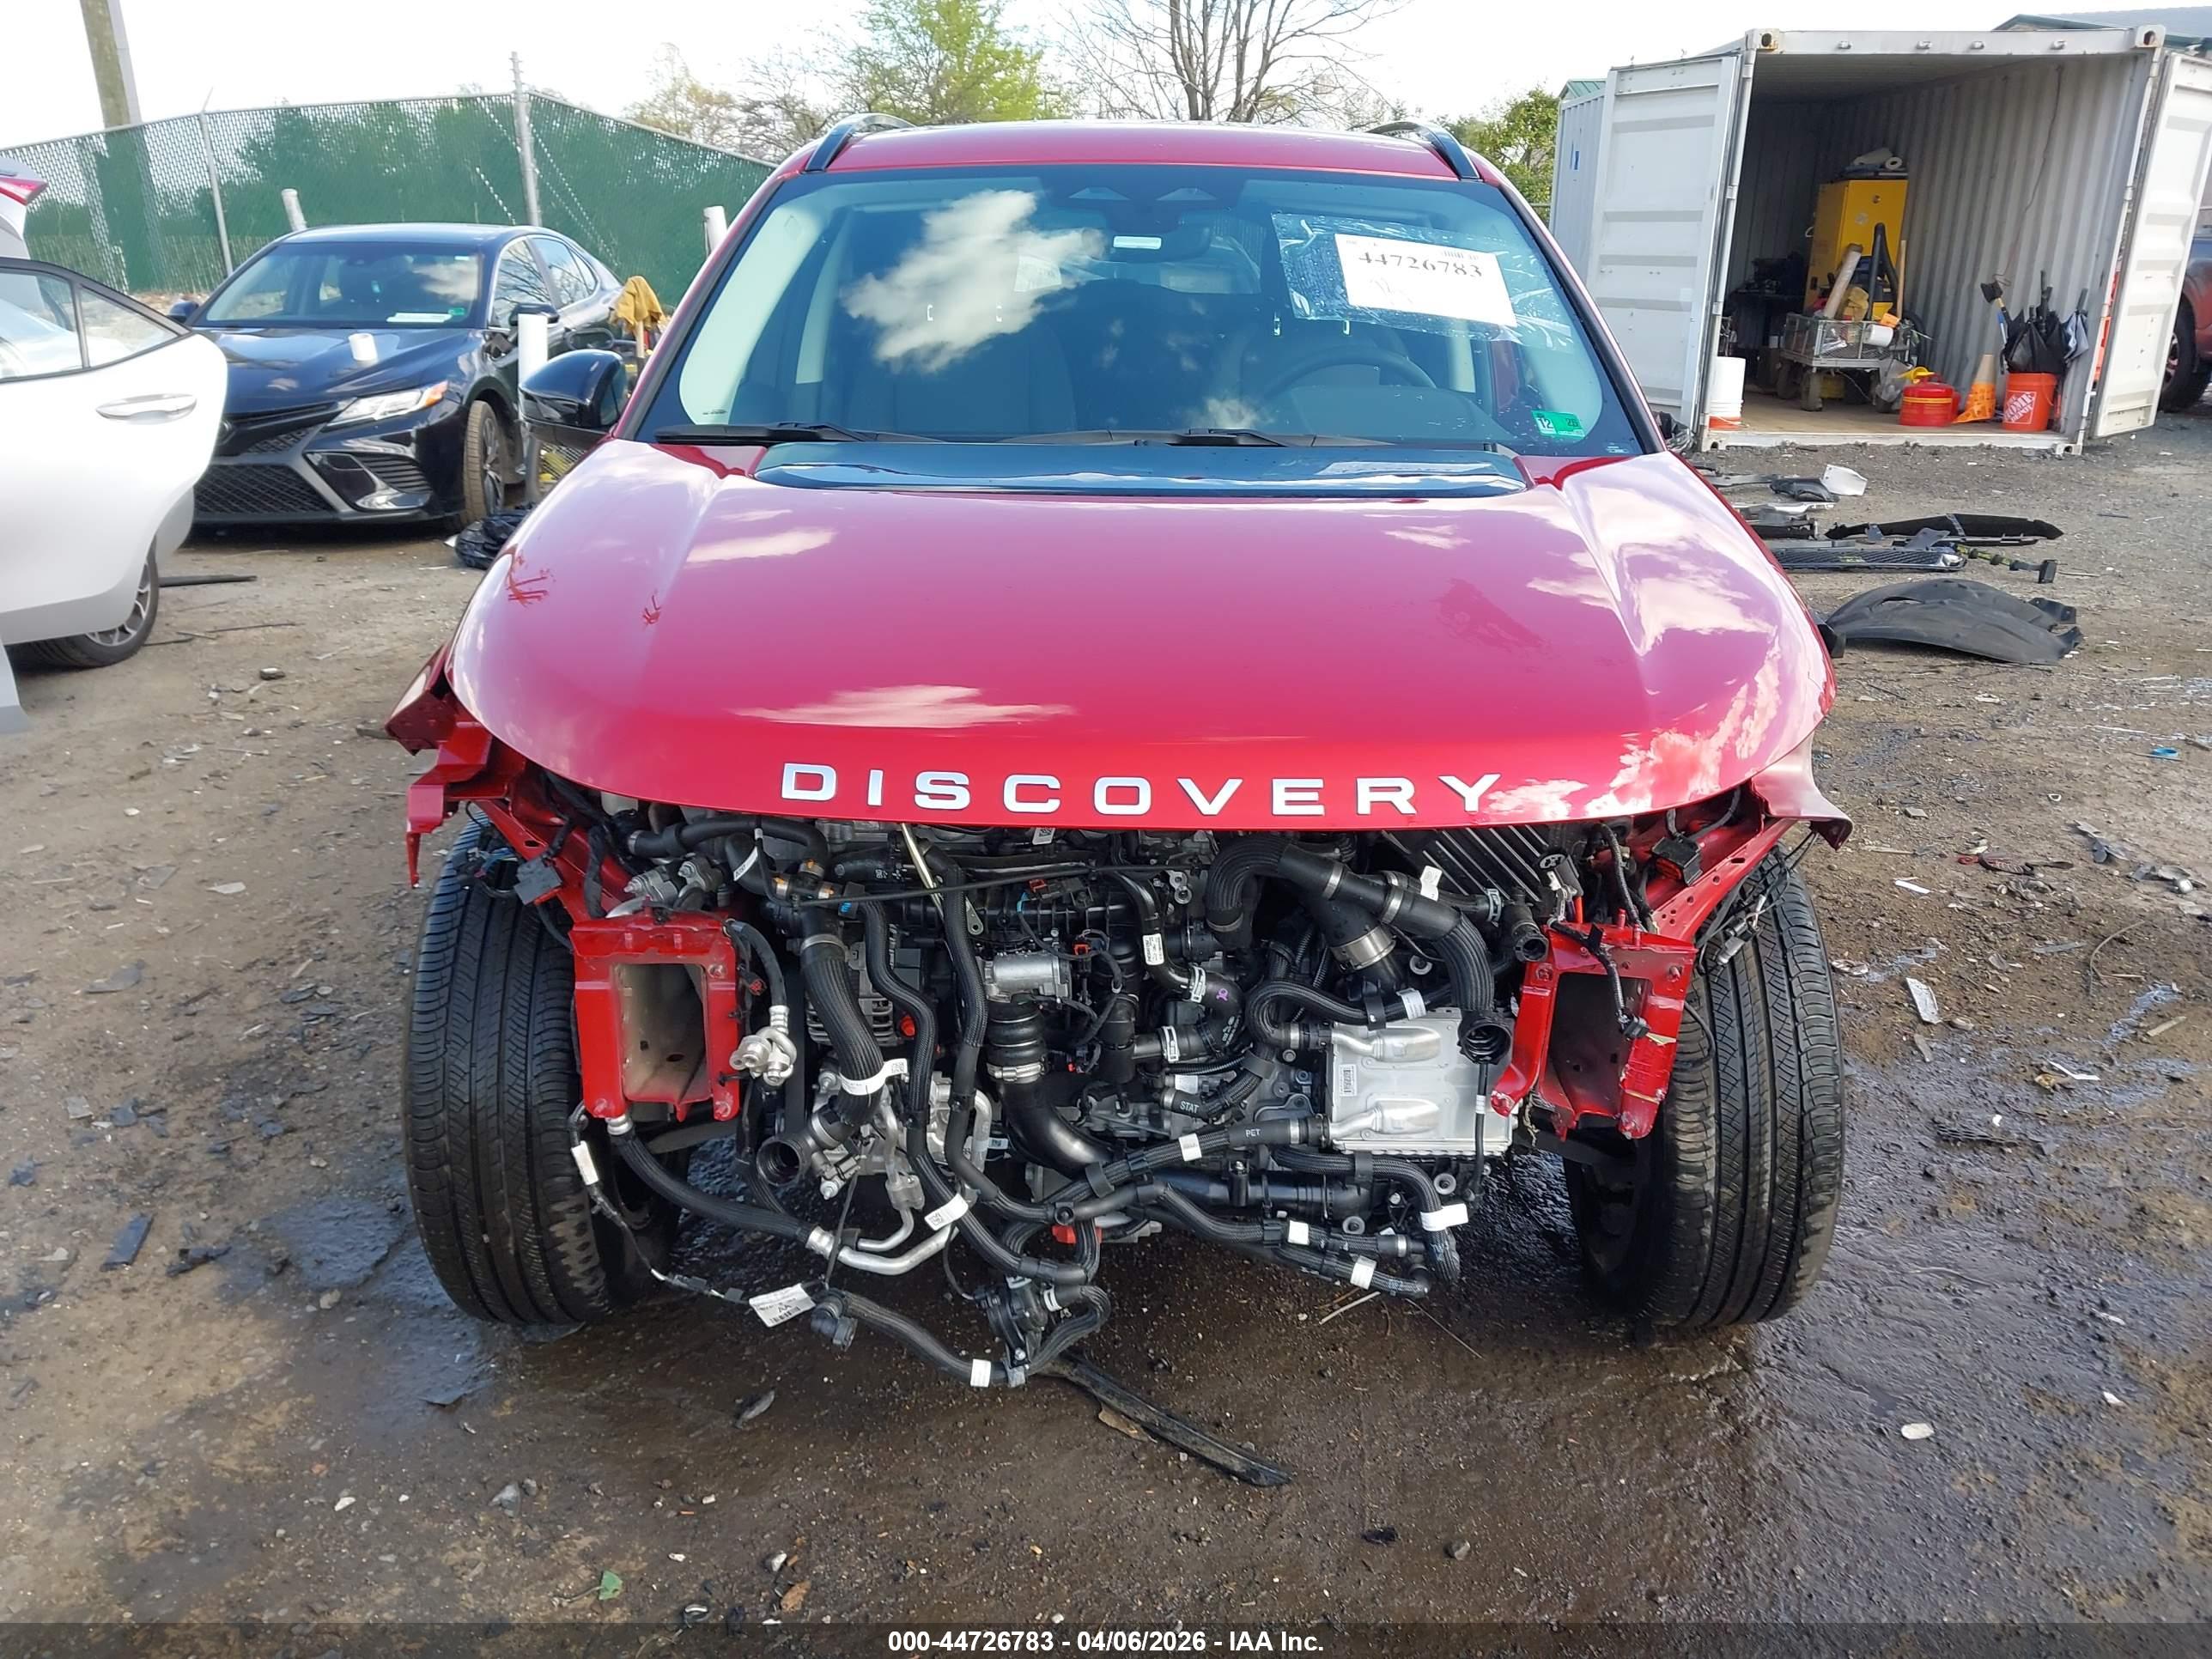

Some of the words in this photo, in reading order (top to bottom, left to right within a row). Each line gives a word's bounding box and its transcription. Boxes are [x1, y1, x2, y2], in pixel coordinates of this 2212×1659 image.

[1358, 252, 1482, 277] 44726783
[781, 762, 1502, 817] DISCOVERY
[1180, 1100, 1200, 1113] STAT
[1245, 1128, 1261, 1138] PET
